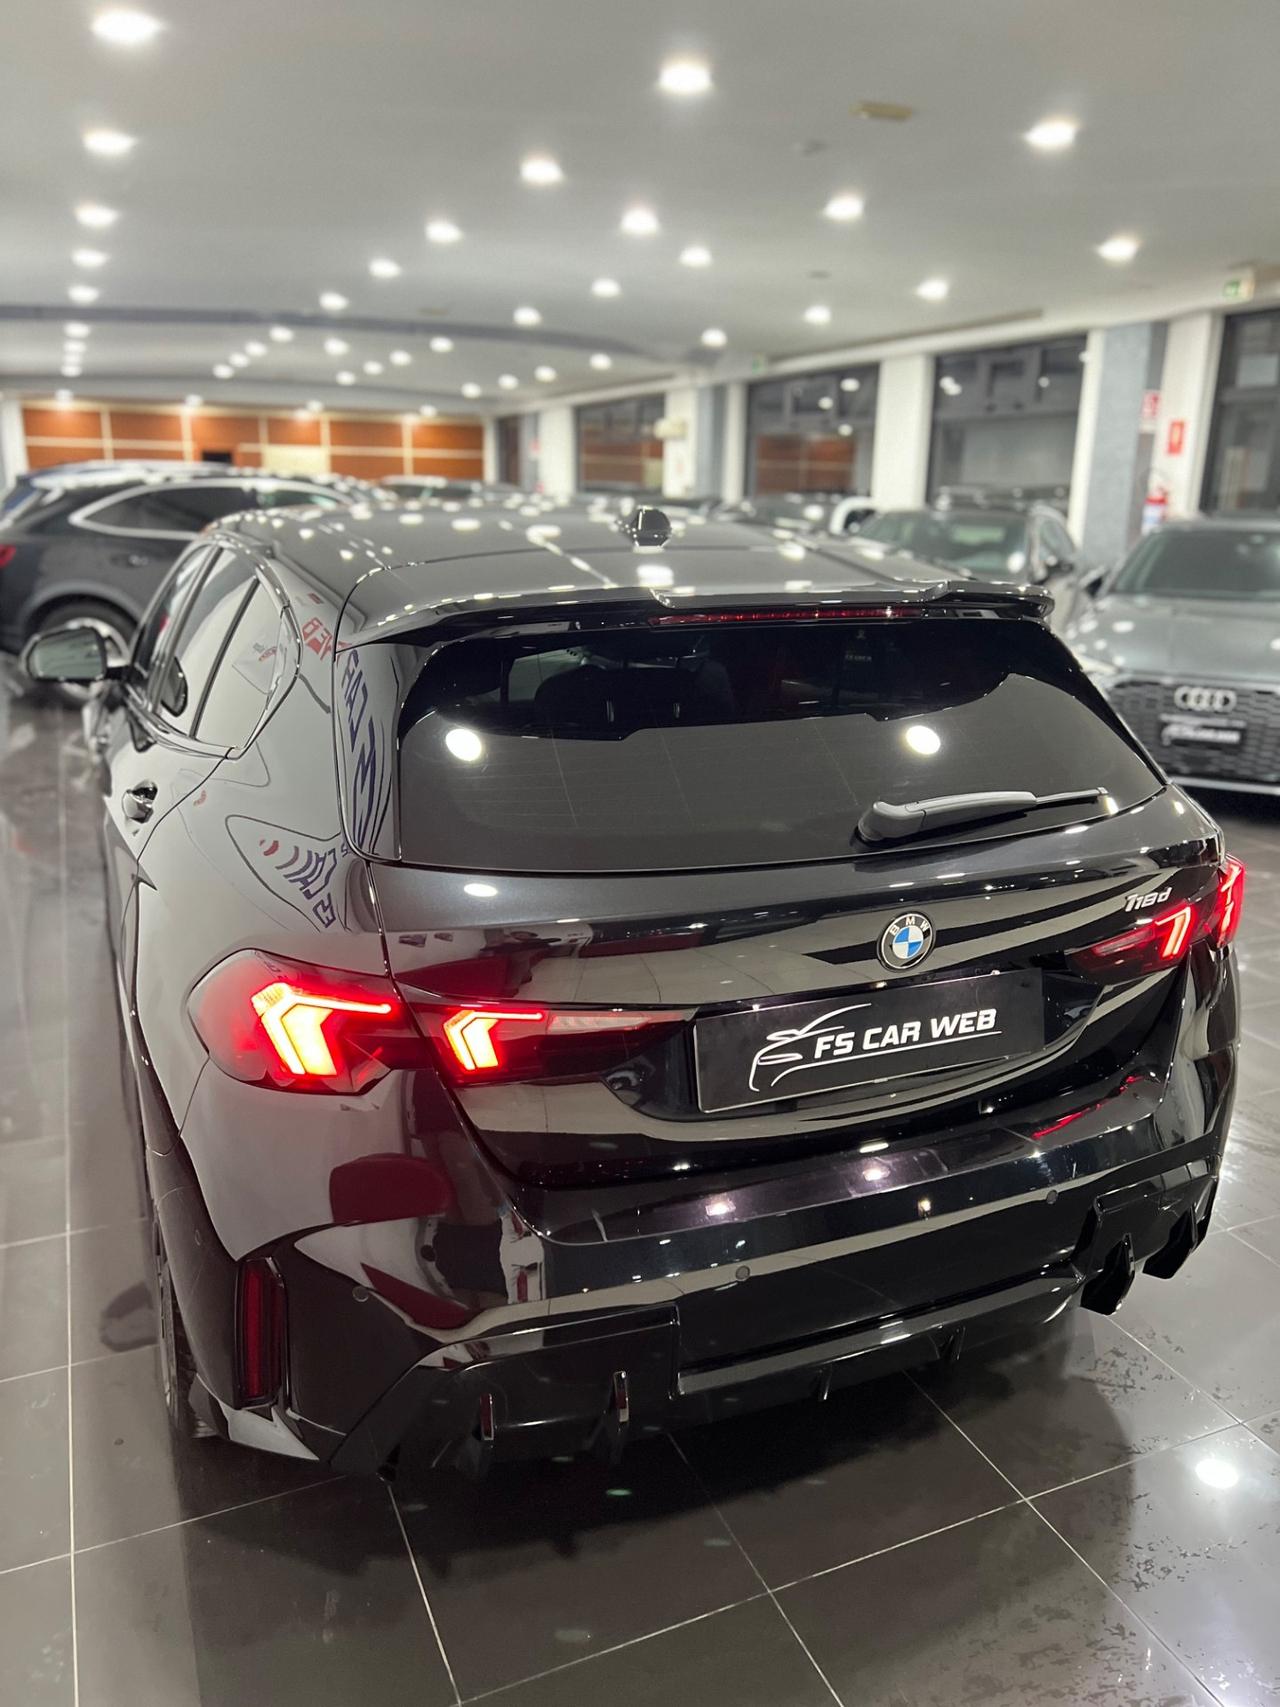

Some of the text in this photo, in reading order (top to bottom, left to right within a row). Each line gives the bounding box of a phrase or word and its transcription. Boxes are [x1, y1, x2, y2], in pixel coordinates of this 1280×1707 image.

[1124, 886, 1173, 913] 118d
[889, 915, 931, 936] BMW
[814, 1008, 998, 1059] FS CAR WEB
